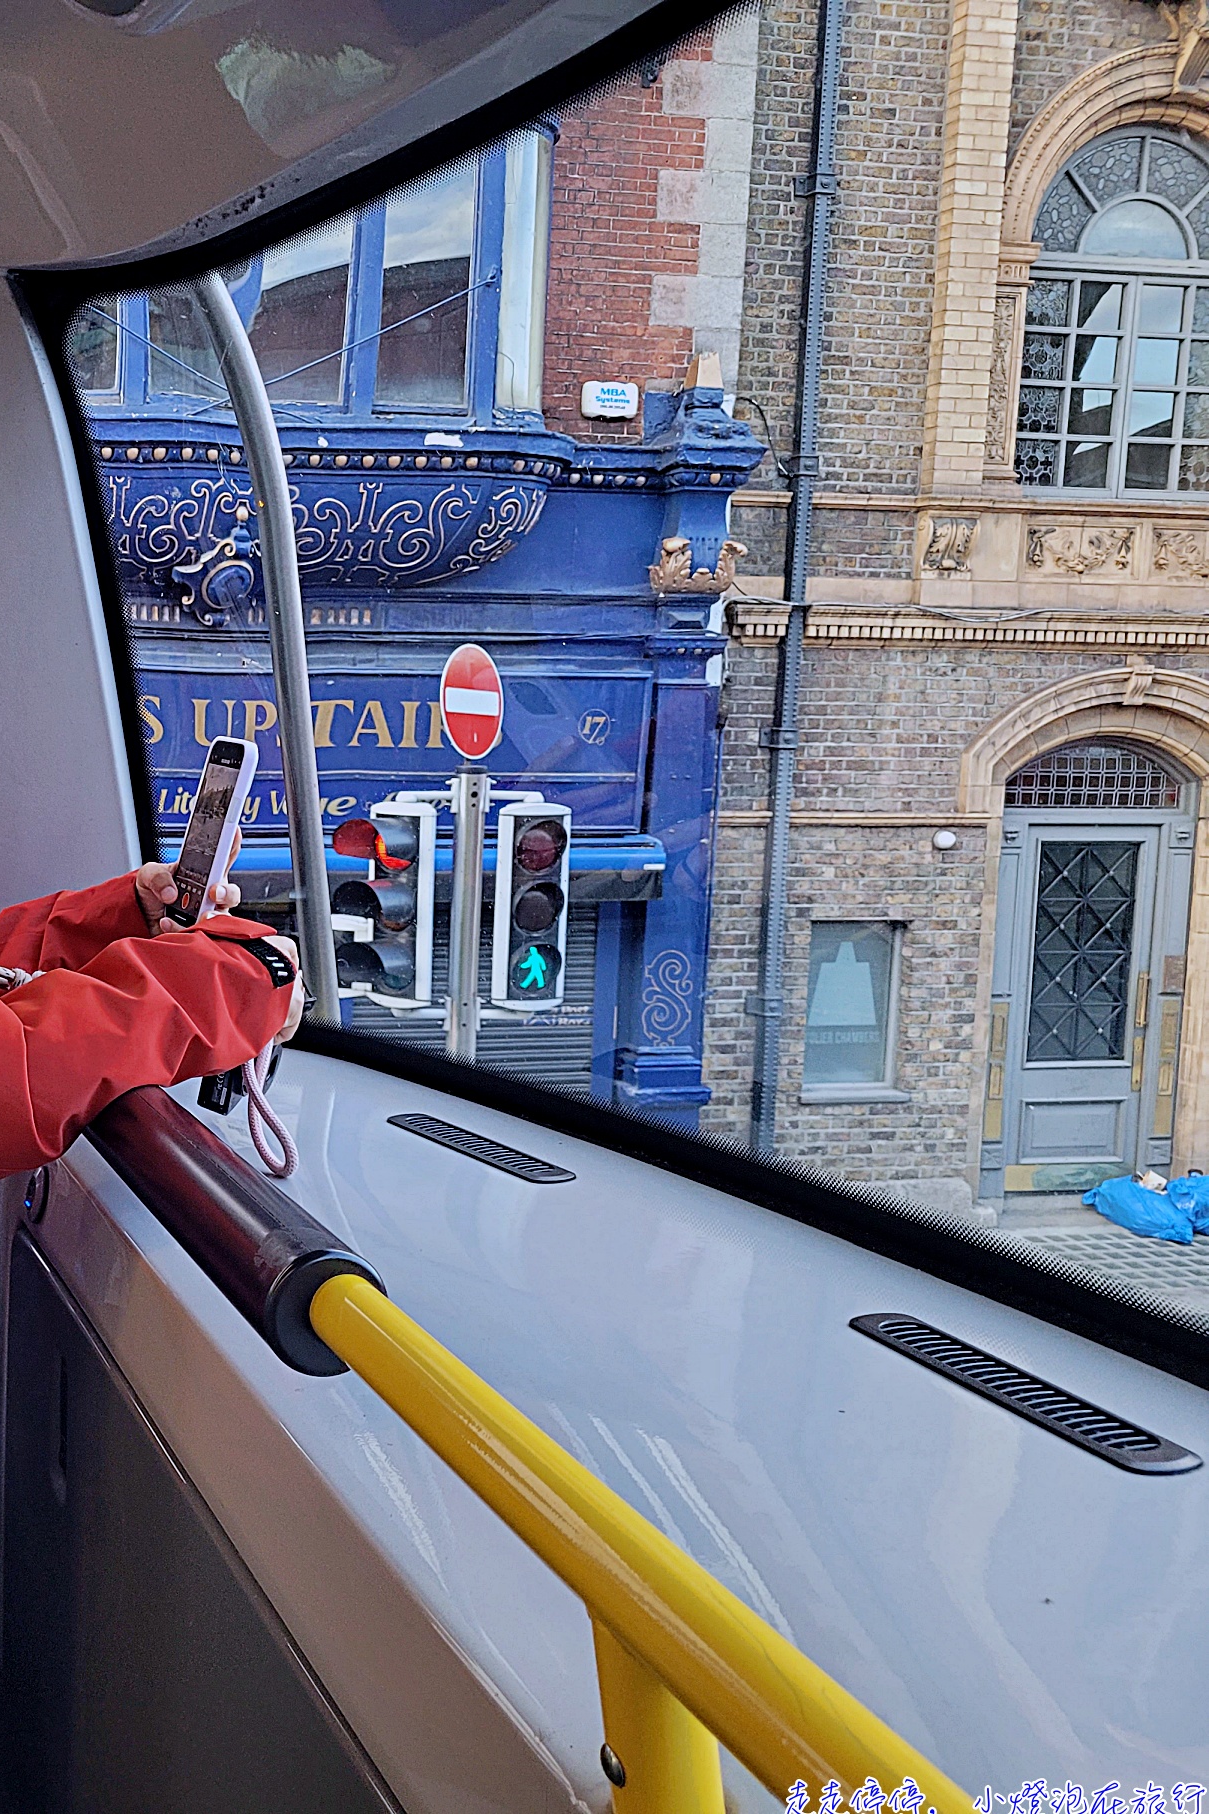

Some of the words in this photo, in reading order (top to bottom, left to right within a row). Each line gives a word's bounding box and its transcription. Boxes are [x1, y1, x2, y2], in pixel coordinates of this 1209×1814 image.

[600, 387, 627, 397] MBA
[595, 395, 631, 404] Systems
[582, 715, 608, 743] 17
